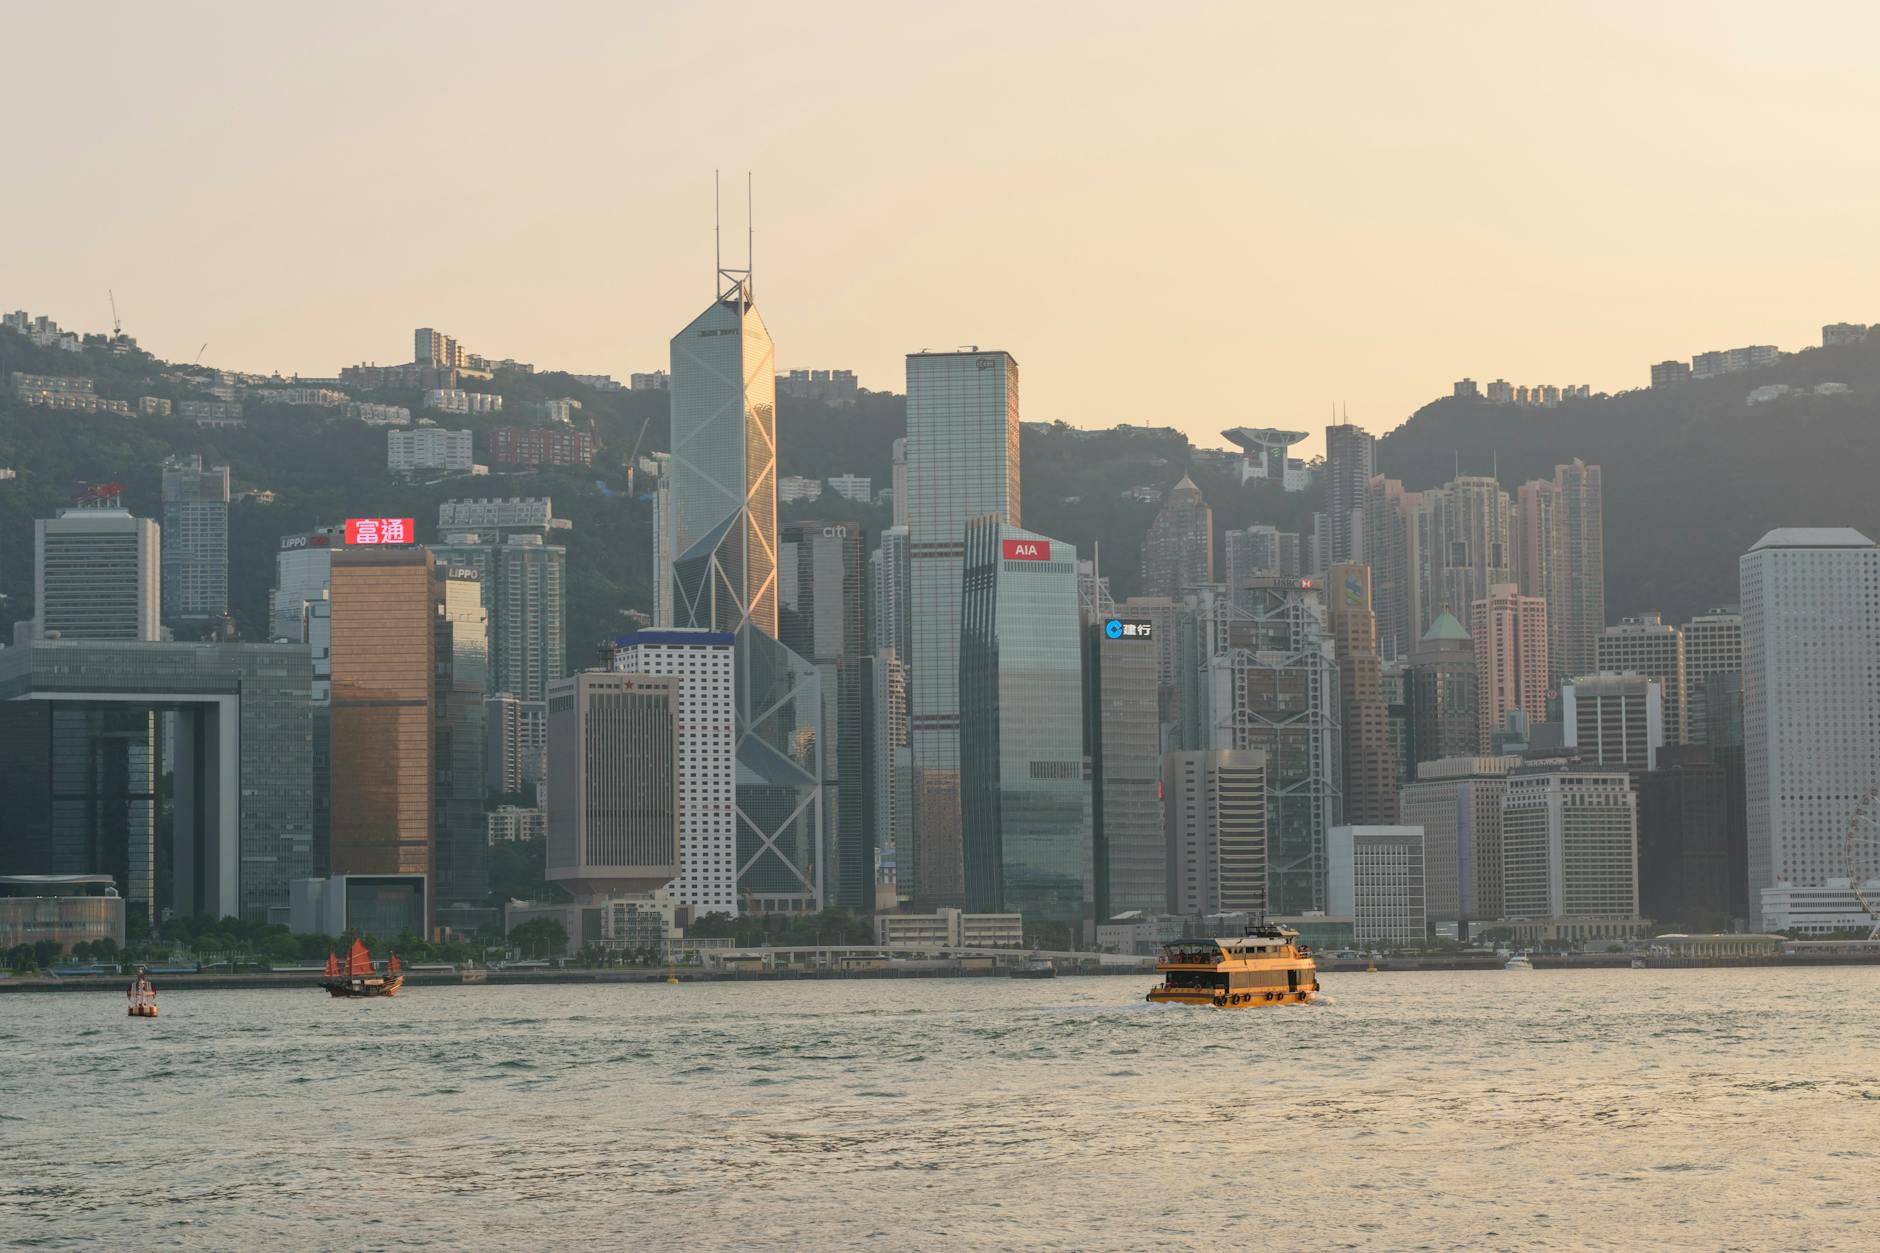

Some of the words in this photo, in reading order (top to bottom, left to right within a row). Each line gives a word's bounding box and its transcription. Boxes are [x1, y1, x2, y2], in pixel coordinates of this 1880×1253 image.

[355, 518, 405, 544] 富通
[822, 525, 847, 538] citi
[281, 536, 307, 549] LIPPO
[1015, 544, 1038, 556] AIA
[449, 568, 478, 580] LIPPO
[1122, 623, 1152, 636] 建行
